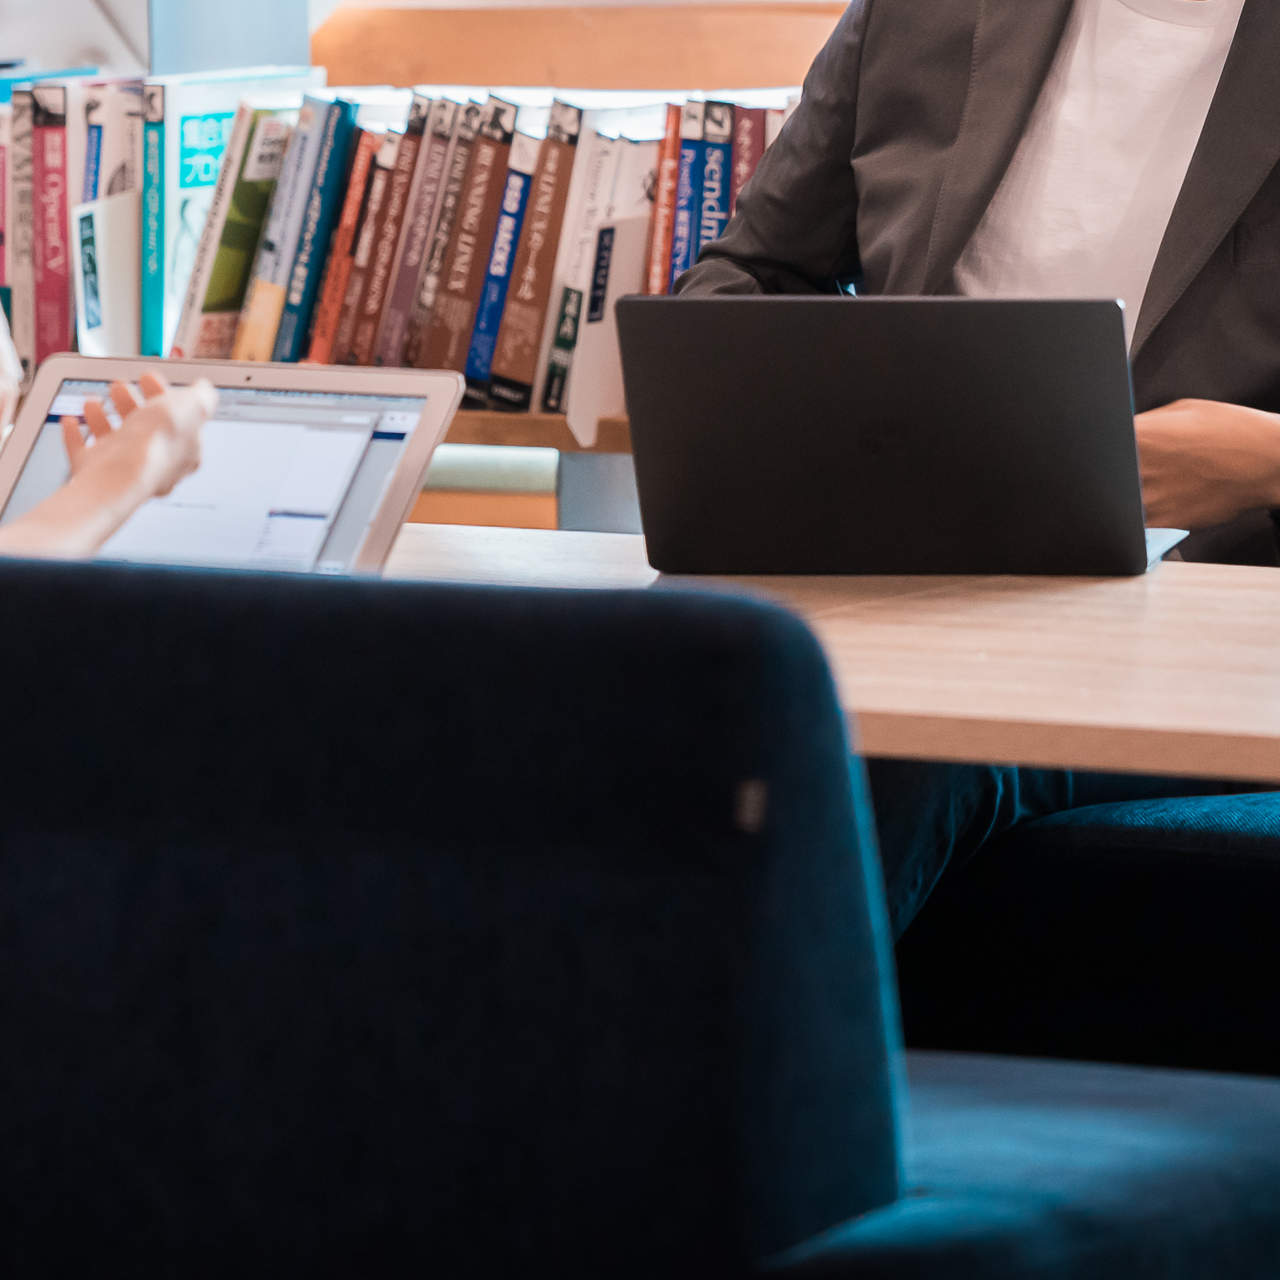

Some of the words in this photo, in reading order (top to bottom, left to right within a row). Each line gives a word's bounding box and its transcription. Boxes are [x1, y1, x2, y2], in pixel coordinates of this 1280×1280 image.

[43, 174, 65, 271] OpenCV
[504, 173, 526, 215] BSD
[701, 147, 725, 244] sendm
[446, 232, 476, 293] LINUX
[488, 216, 520, 278] HACKS
